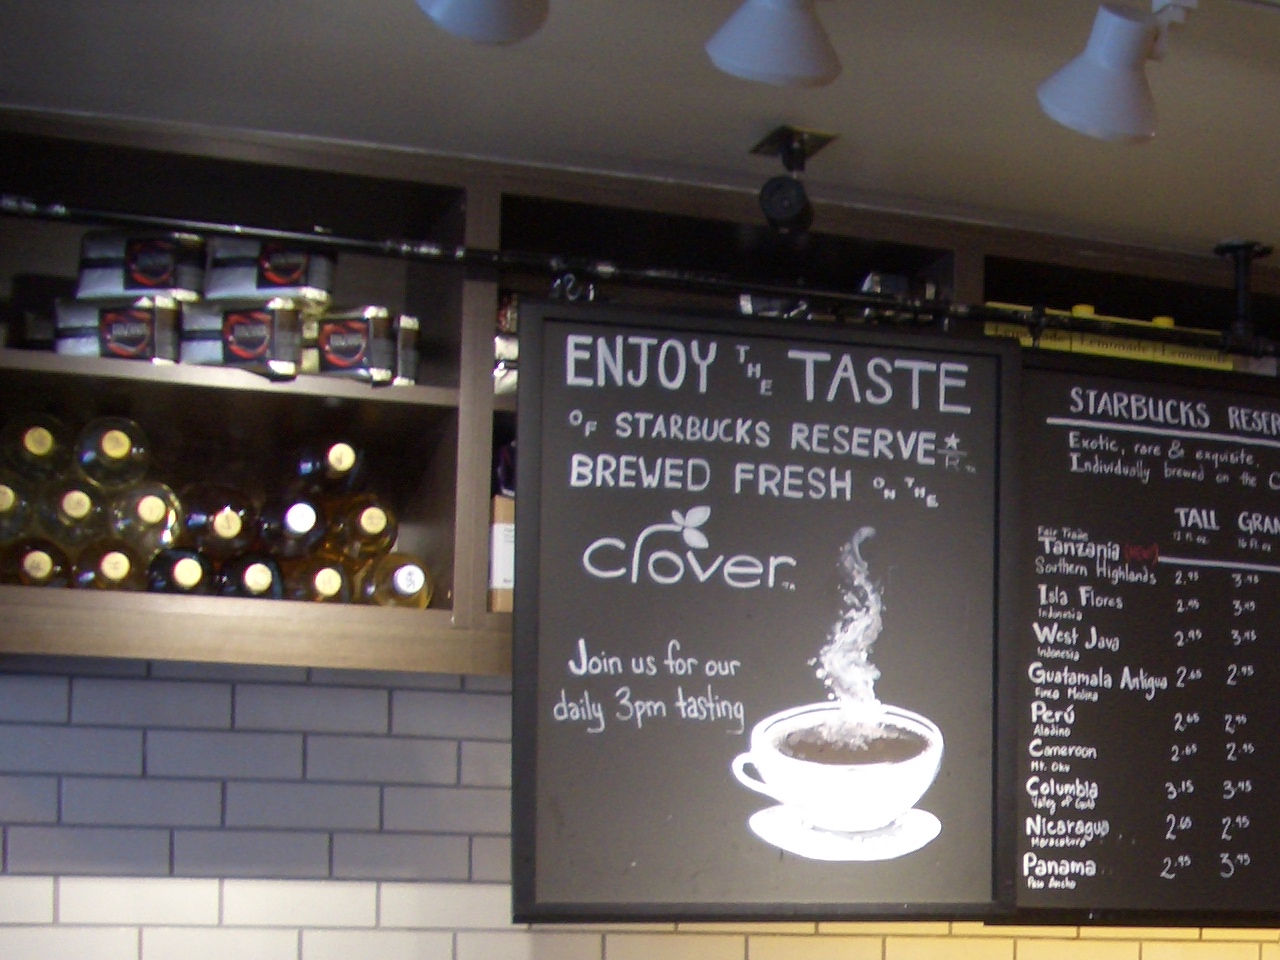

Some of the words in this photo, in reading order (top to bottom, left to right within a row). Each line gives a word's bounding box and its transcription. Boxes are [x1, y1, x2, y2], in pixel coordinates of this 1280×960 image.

[564, 334, 717, 394] ENJOY
[735, 345, 773, 396] THE
[788, 349, 971, 415] TASTE
[1070, 386, 1211, 430] STARBUCKS
[569, 409, 597, 437] OF
[615, 411, 771, 448] STARBUCKS
[791, 421, 937, 466] RESERVE
[1133, 443, 1161, 457] rare
[1167, 440, 1185, 459] &
[569, 453, 711, 492] BREWED
[734, 463, 852, 501] FRESH
[873, 476, 896, 500] ON
[904, 476, 939, 508] THE
[1069, 452, 1151, 485] Individually
[1164, 461, 1205, 482] brewed
[1215, 472, 1230, 484] on
[1239, 472, 1257, 487] the
[1174, 507, 1220, 531] TALL
[1038, 537, 1120, 561] Tanzania
[1035, 555, 1087, 576] Southern
[1096, 556, 1157, 585] Highlands
[1038, 583, 1068, 606] Isla
[1078, 585, 1123, 609] Flores
[1032, 621, 1079, 645] West
[1085, 625, 1119, 651] Java
[568, 638, 622, 676] Join
[631, 658, 658, 677] us
[663, 638, 699, 677] for
[705, 658, 742, 678] our
[1120, 665, 1168, 700] Antigua
[552, 689, 605, 734] daily
[615, 685, 667, 729] 3pm
[675, 684, 746, 735] tasting
[1031, 700, 1075, 724] Perú
[1028, 738, 1097, 759] Cameroon
[1026, 776, 1099, 799] Columbia
[1025, 814, 1110, 841] Nicaragua
[1023, 852, 1096, 877] Panama
